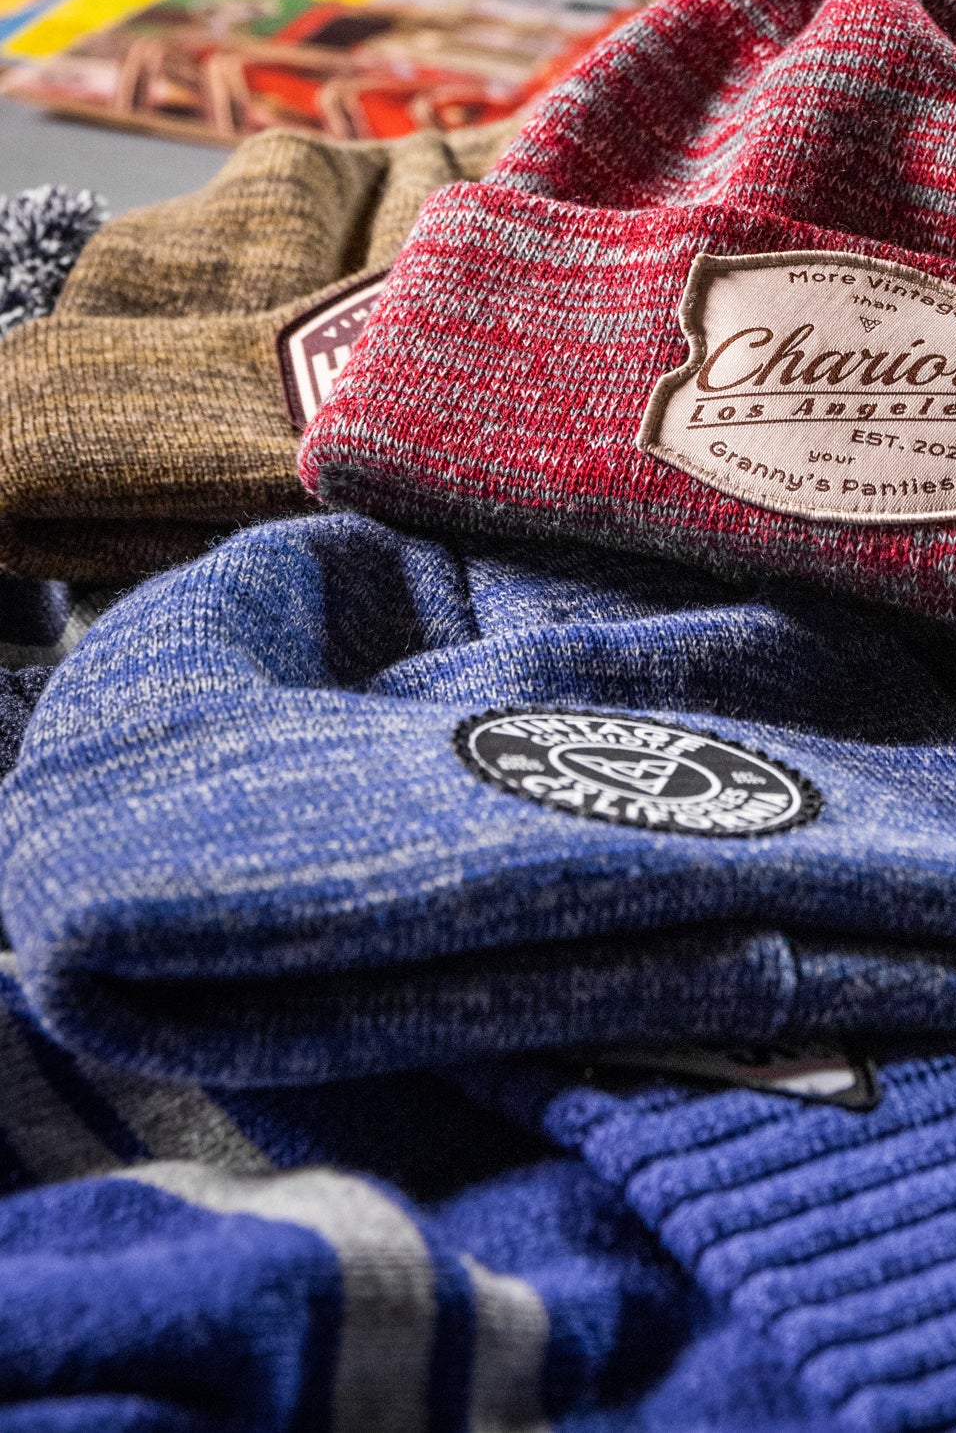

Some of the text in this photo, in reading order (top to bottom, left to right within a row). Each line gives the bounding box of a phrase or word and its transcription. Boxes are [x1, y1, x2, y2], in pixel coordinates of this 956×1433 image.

[789, 270, 856, 286] More
[852, 293, 898, 313] than
[690, 403, 765, 423] Los
[850, 429, 905, 450] EST.
[807, 447, 858, 466] your
[709, 440, 955, 497] Granny's Panties
[490, 717, 706, 754] VINTAGE
[530, 731, 685, 757] CHARIOTS
[522, 774, 789, 830] CALIFORNIA
